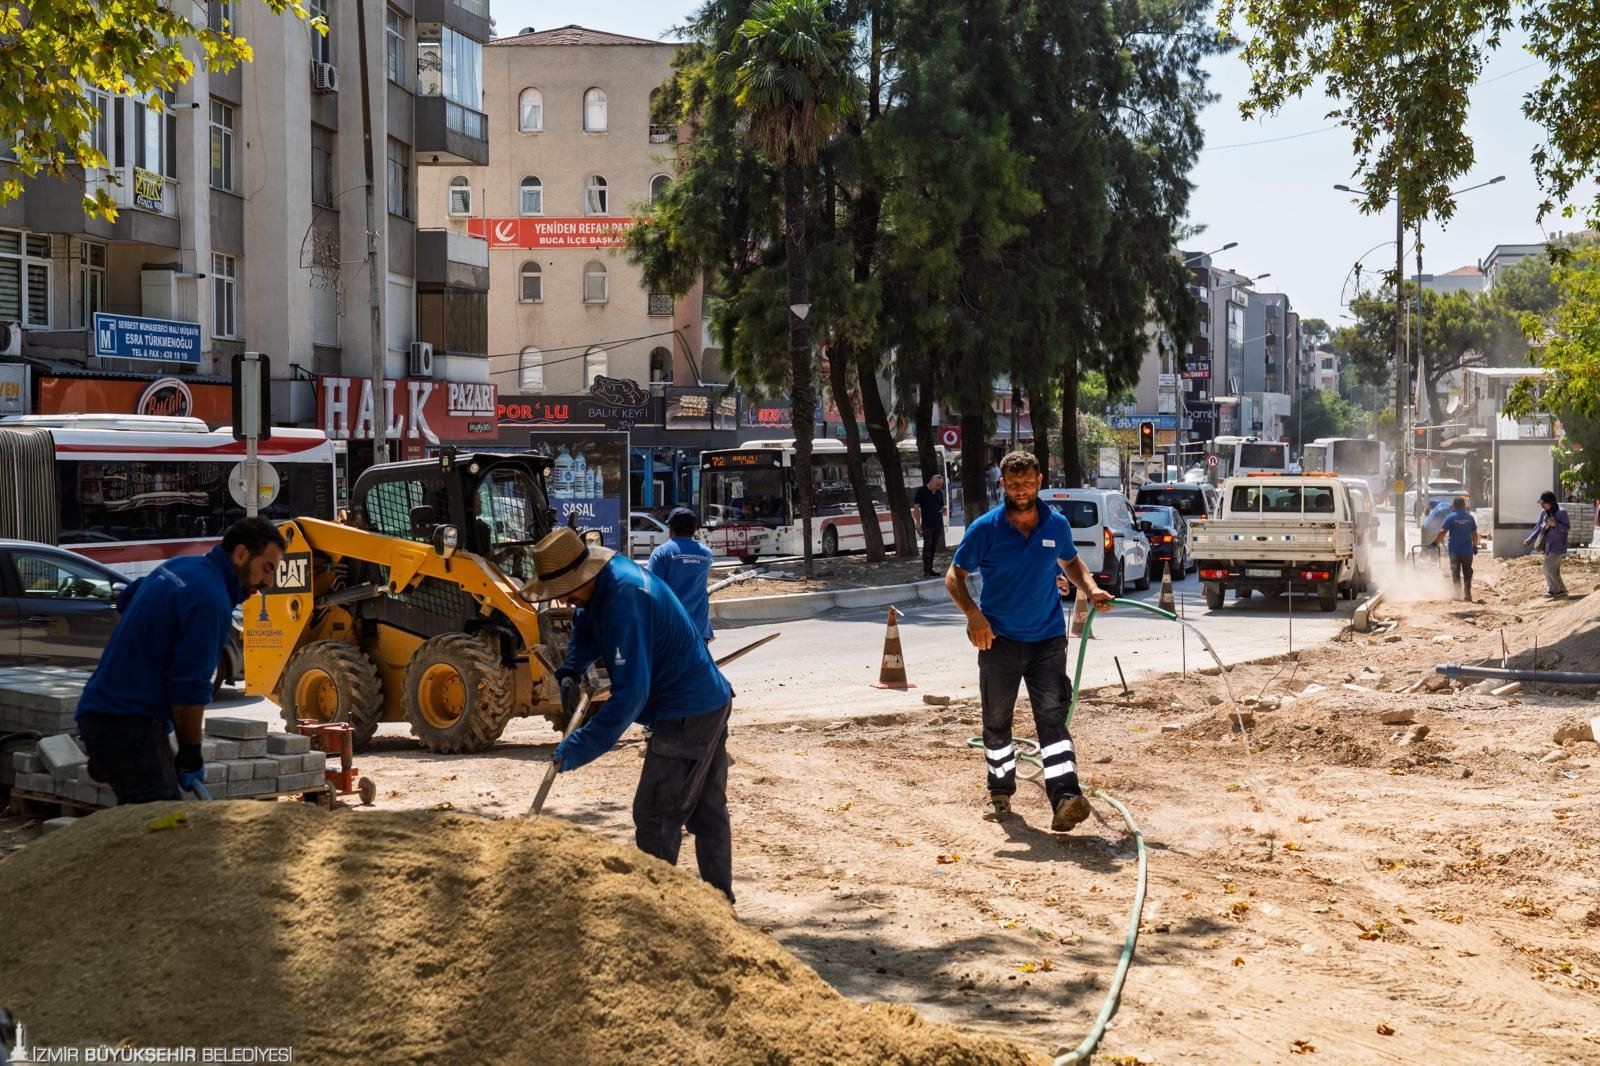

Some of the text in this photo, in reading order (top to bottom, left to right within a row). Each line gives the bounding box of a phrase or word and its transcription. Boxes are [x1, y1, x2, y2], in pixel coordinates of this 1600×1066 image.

[535, 221, 577, 234] YENİDEN
[579, 223, 609, 234] REFAH
[539, 236, 623, 246] BUCA İLÇE BAŞKA
[118, 320, 139, 330] SERBEST
[139, 322, 169, 333] MUHASEBECİ
[168, 324, 180, 334] MALİ
[125, 333, 193, 349] ESRA TÜRKMENOĞLU
[132, 348, 142, 357] TEL
[149, 349, 160, 358] FAX
[163, 350, 173, 359] 438
[448, 383, 495, 411] PAZARI
[322, 377, 440, 445] HALK
[588, 406, 648, 418] BALIK KEYFİ
[276, 558, 308, 588] CAT
